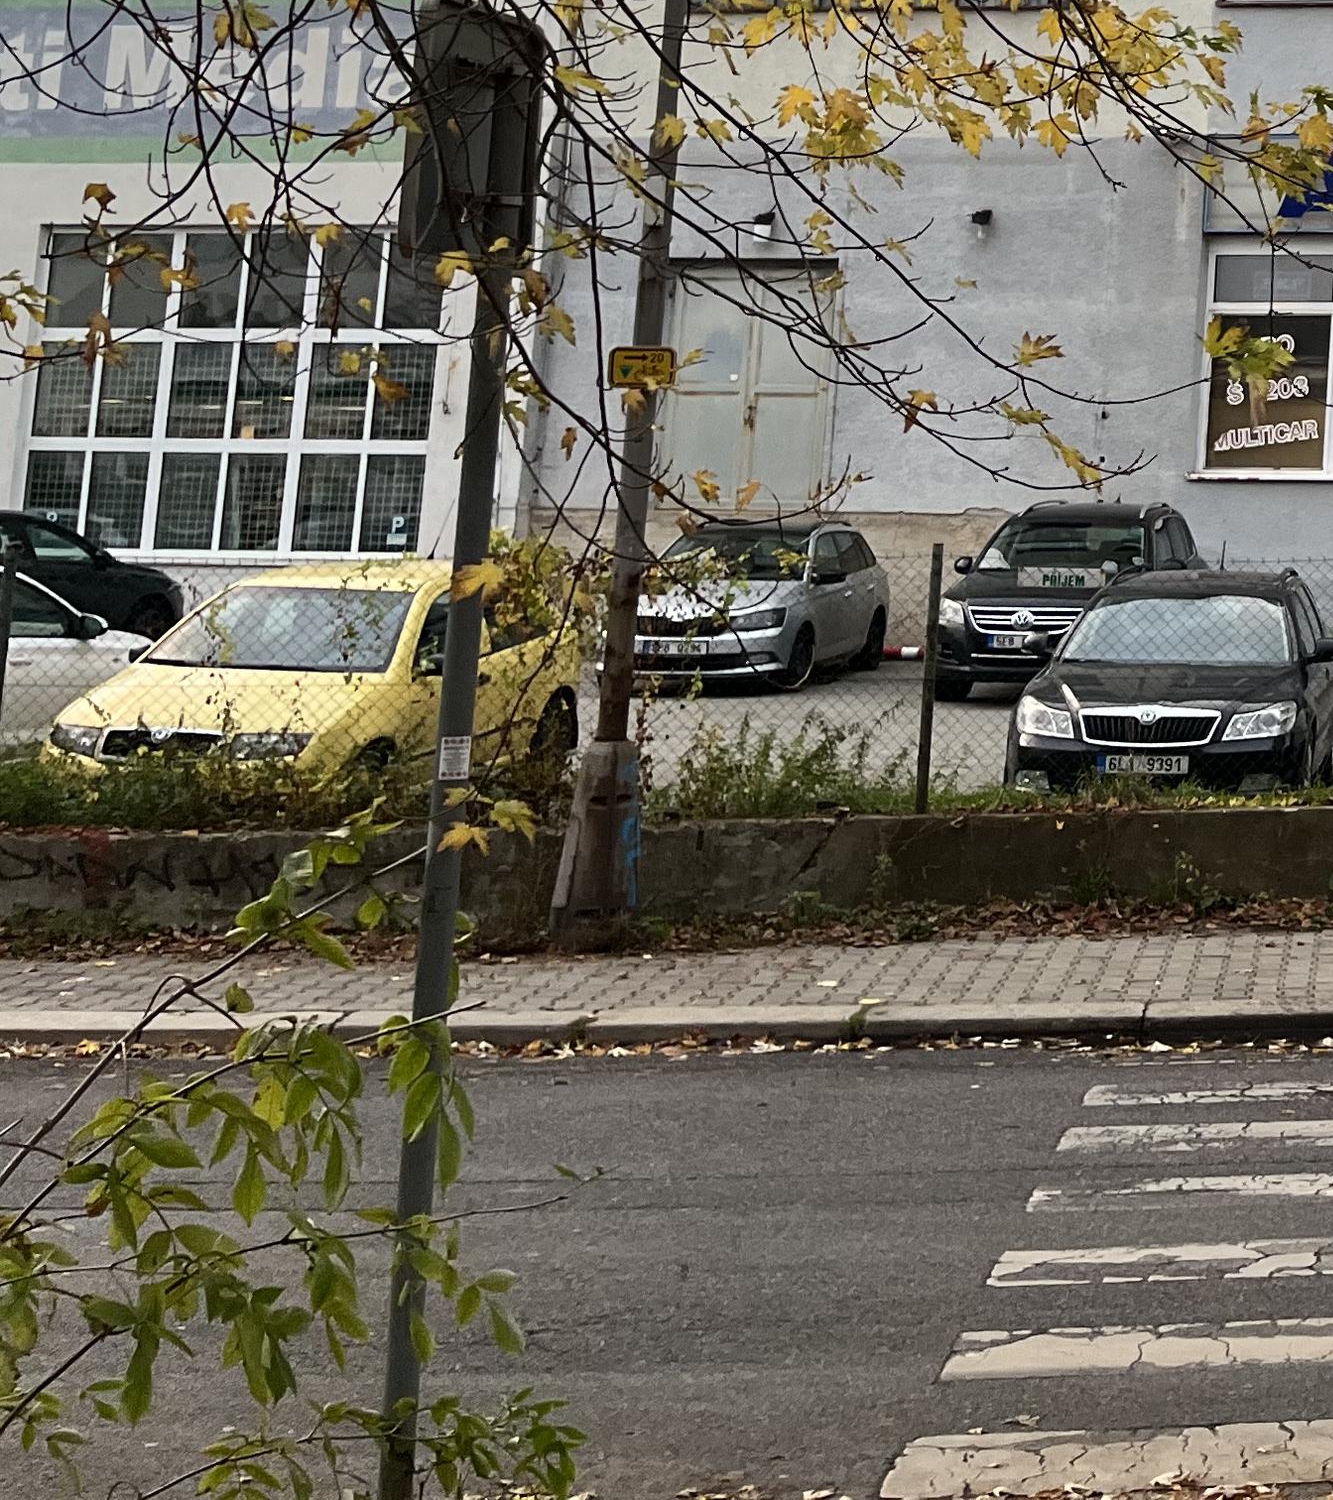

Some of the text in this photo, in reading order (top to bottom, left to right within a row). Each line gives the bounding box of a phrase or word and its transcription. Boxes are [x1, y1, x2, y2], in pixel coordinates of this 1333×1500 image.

[392, 516, 405, 534] P
[1108, 757, 1181, 772] 6L1 9391
